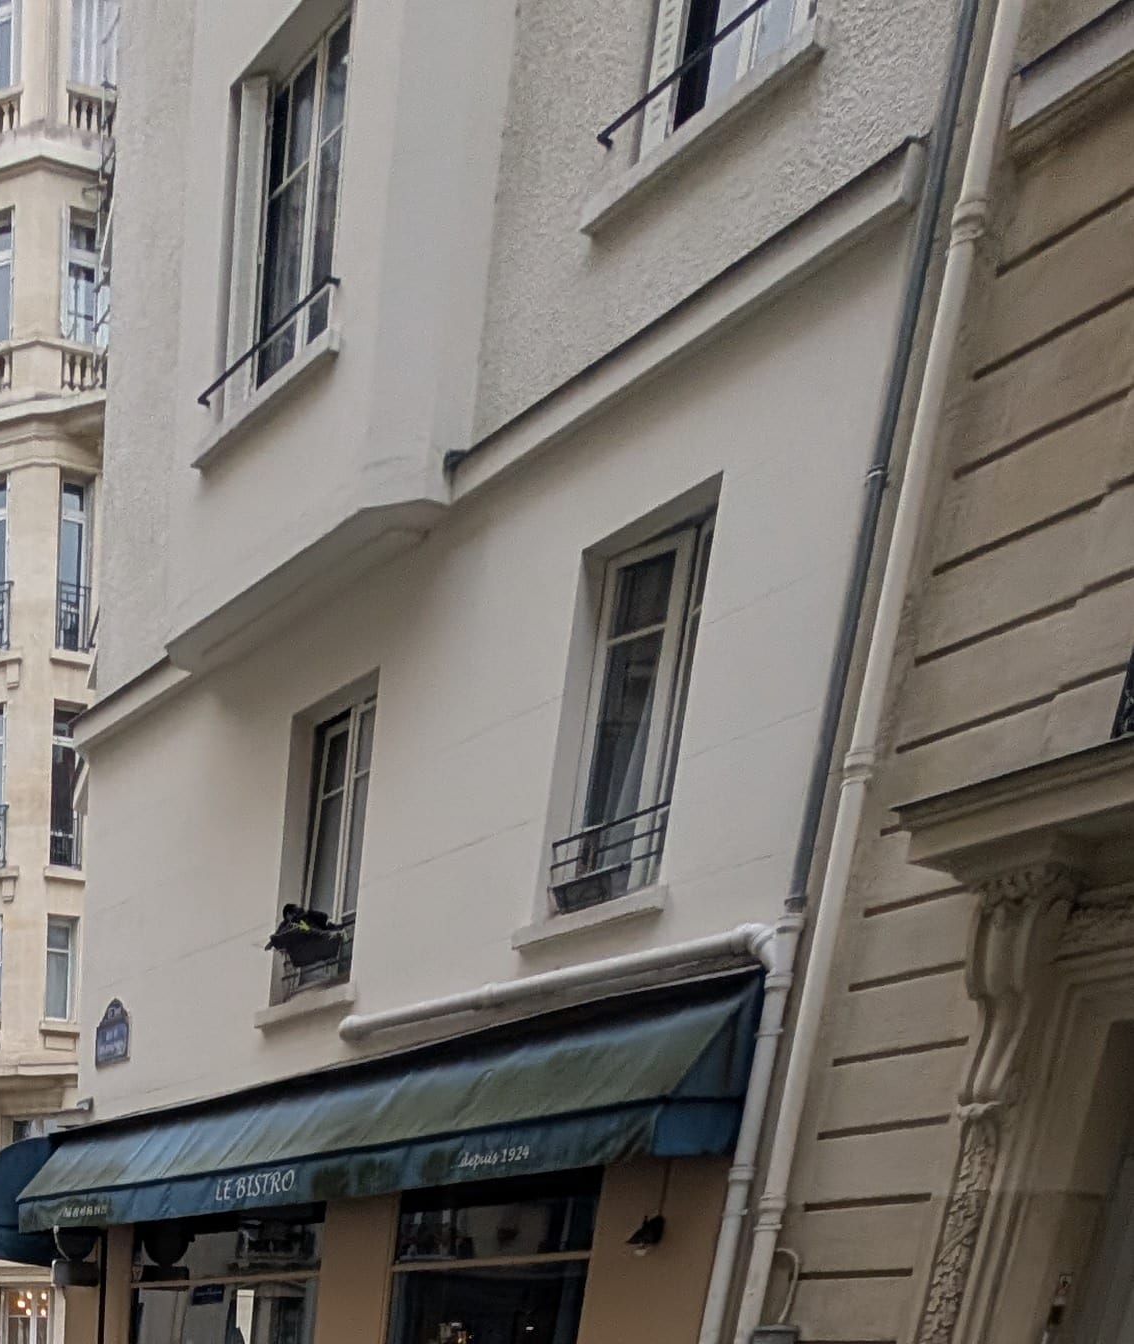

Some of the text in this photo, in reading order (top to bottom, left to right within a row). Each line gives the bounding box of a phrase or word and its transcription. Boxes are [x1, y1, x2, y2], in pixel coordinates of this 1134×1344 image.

[500, 1145, 529, 1163] 1924
[215, 1169, 295, 1201] LE BISTRO
